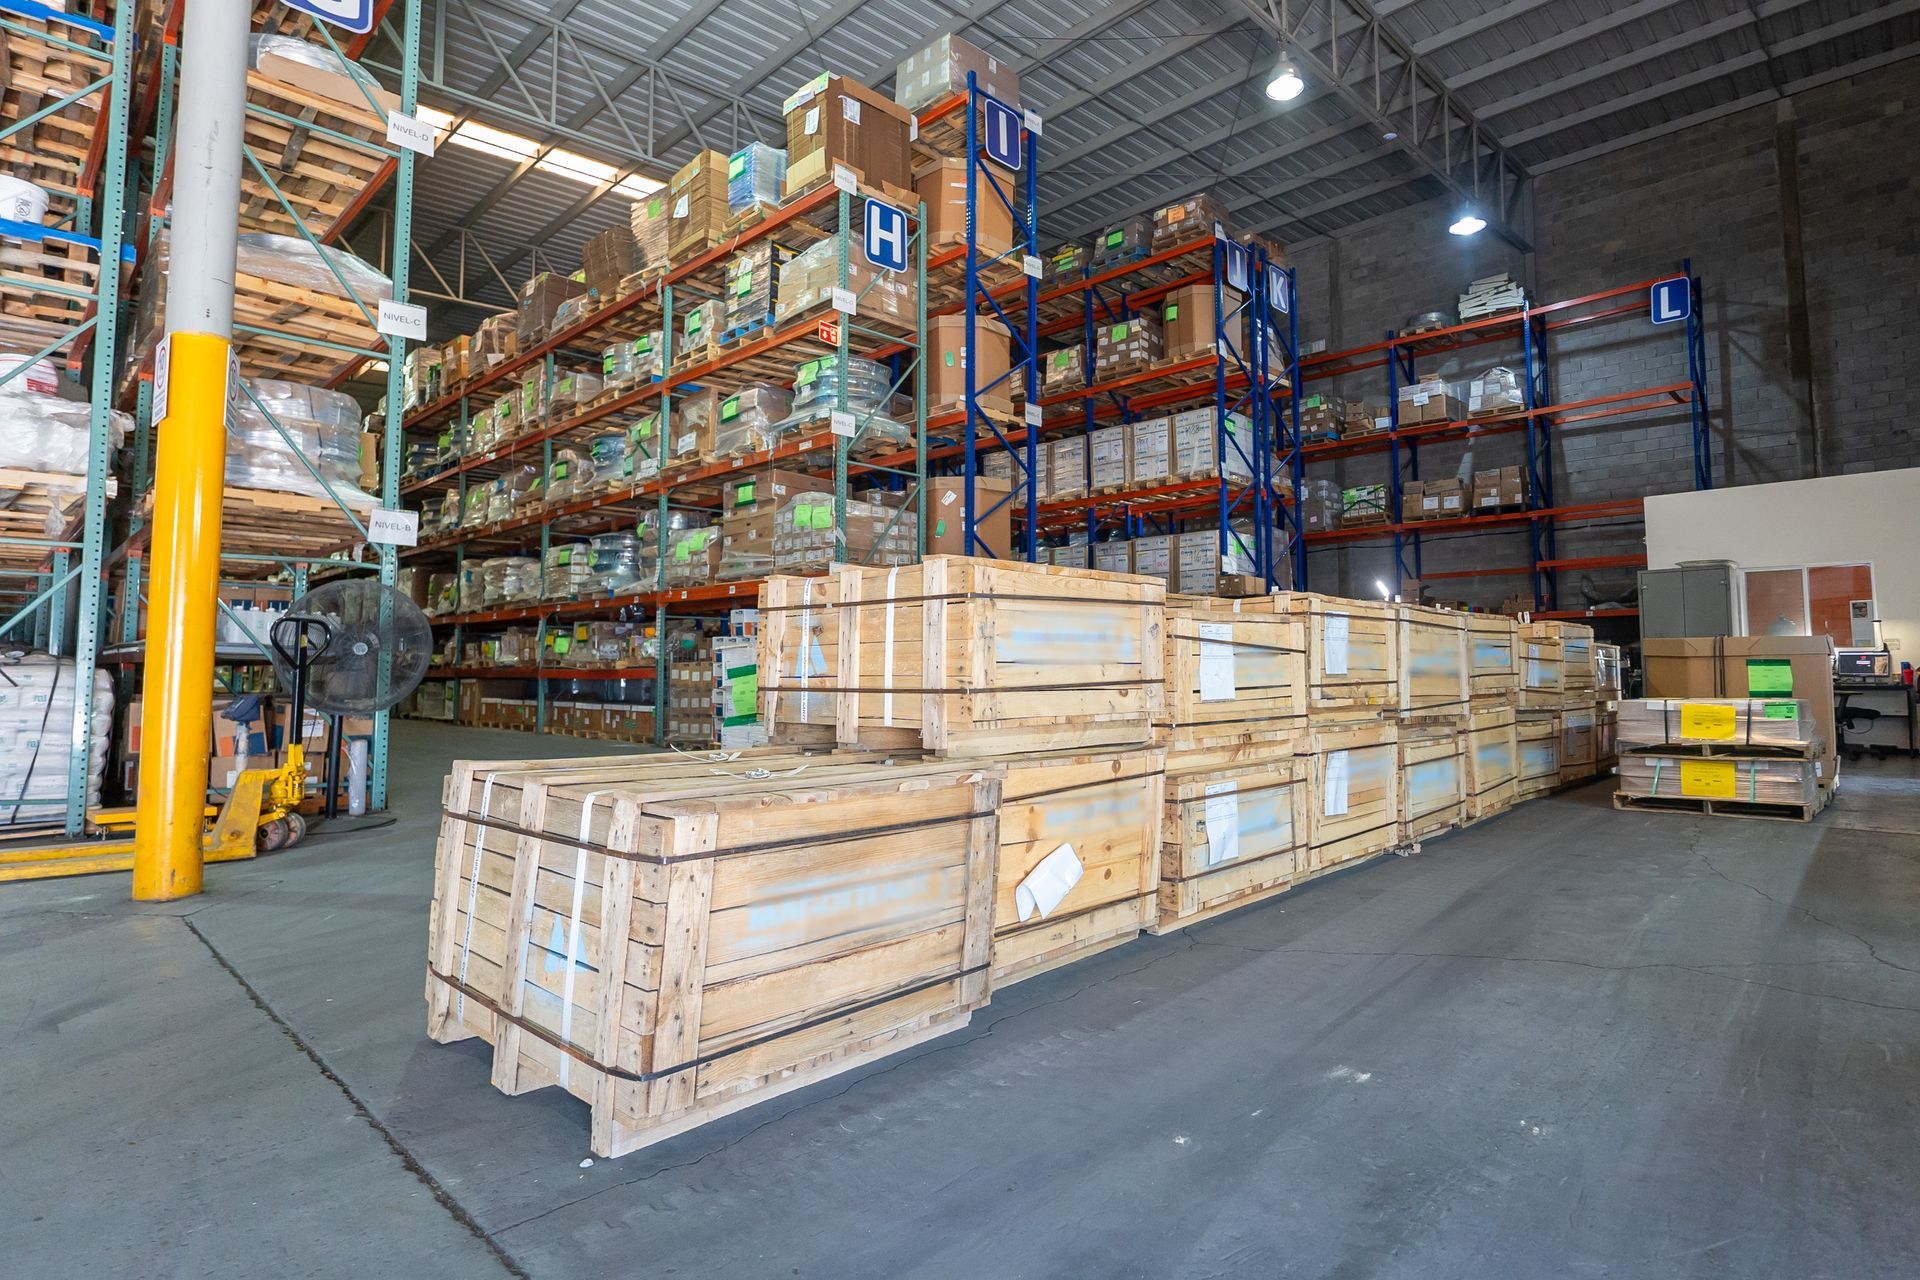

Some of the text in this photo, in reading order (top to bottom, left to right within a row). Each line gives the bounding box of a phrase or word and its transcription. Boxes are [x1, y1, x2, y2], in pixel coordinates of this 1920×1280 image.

[392, 122, 429, 142] NIVEL-D
[870, 204, 902, 264] H
[1232, 249, 1241, 282] J
[1271, 271, 1286, 309] K
[1660, 286, 1681, 319] L
[383, 312, 421, 326] NIVEL-C
[374, 520, 412, 532] NIVEL-B
